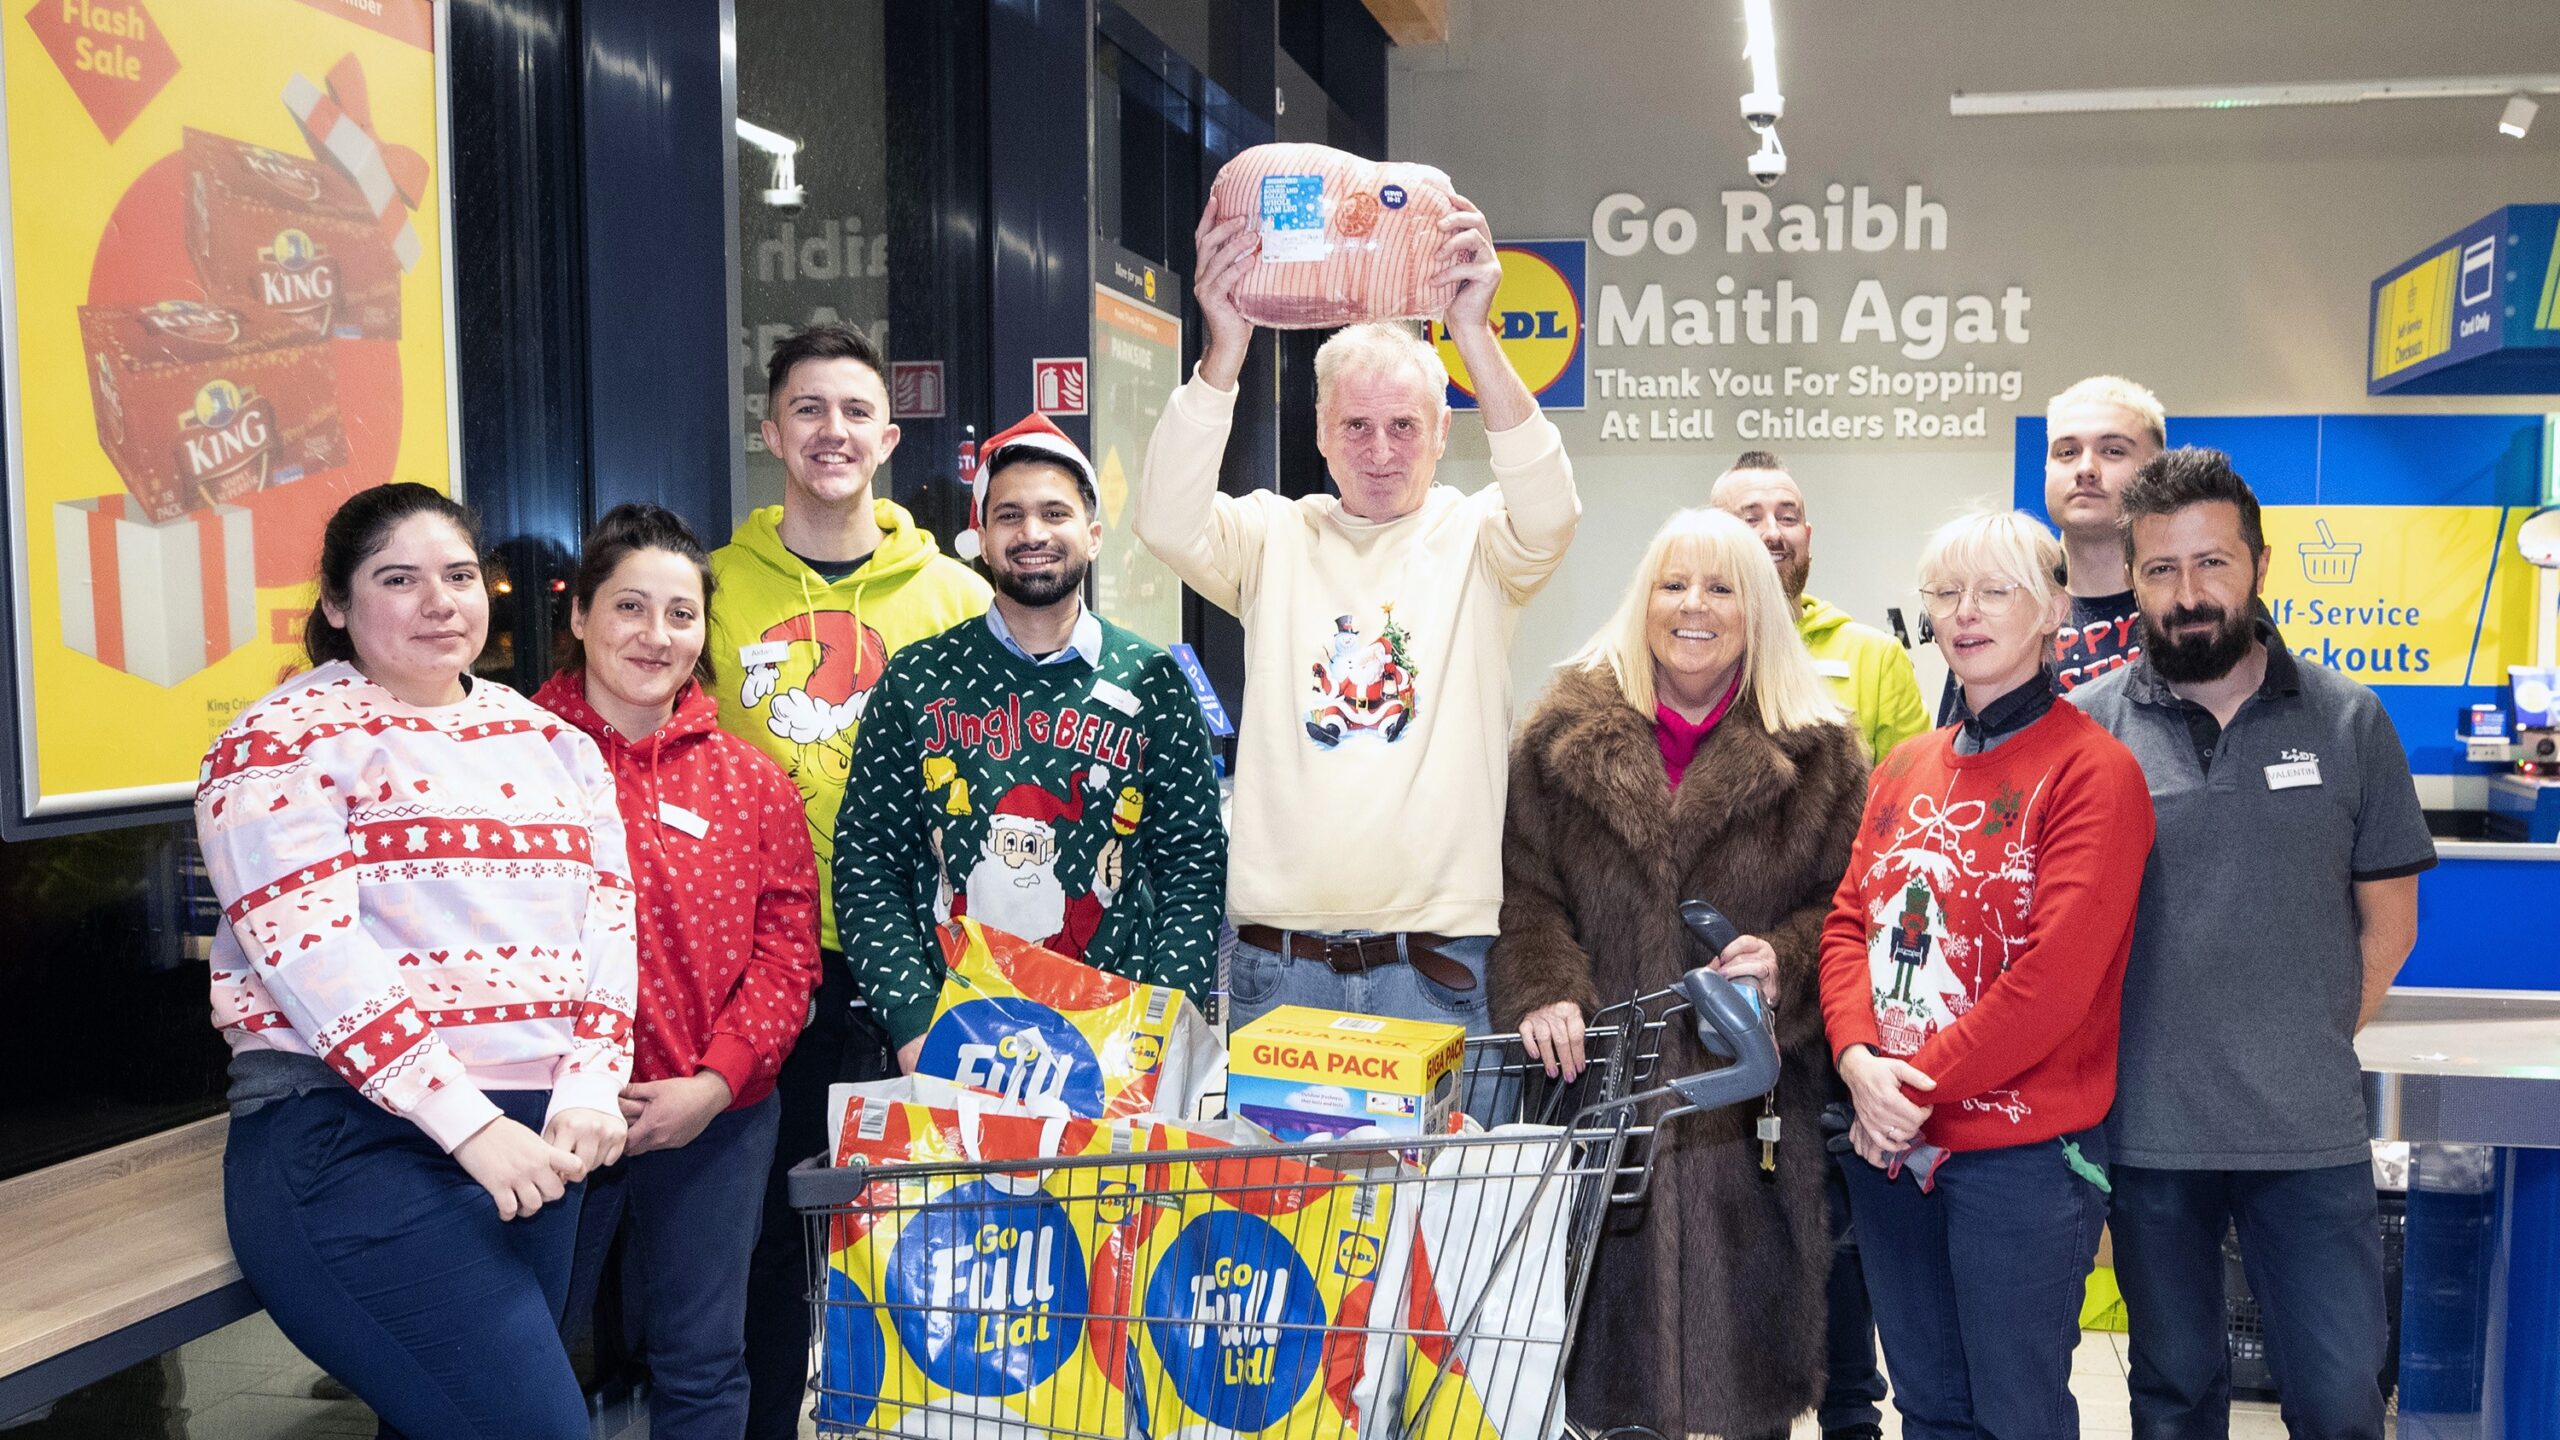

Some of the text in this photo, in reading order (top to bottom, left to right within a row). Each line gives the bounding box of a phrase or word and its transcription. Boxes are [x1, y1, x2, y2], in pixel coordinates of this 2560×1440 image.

[63, 0, 145, 41] Flash
[75, 35, 142, 81] Sale
[1592, 183, 1948, 256] Go Raibh
[258, 265, 333, 305] KING
[1597, 275, 2031, 360] Maith Agat
[1595, 362, 2022, 402] Thank You For Shopping
[185, 411, 267, 475] KING
[1601, 406, 1986, 440] At Lidl Childers Road
[2273, 598, 2420, 626] lf-Service
[2055, 612, 2140, 661] PPY
[207, 700, 230, 713] King
[924, 692, 1150, 773] Jingle BELLY
[1266, 1027, 1411, 1049] GIGA PACK
[1426, 1036, 1465, 1080] GIGA PACK
[1253, 1044, 1399, 1080] GIGA PACK
[975, 1223, 1018, 1254] Go
[931, 1225, 1055, 1324] Full
[1215, 1257, 1252, 1288] Go
[974, 1303, 1050, 1353] Lidl
[1188, 1267, 1289, 1349] Full
[1224, 1346, 1275, 1386] Lidl
